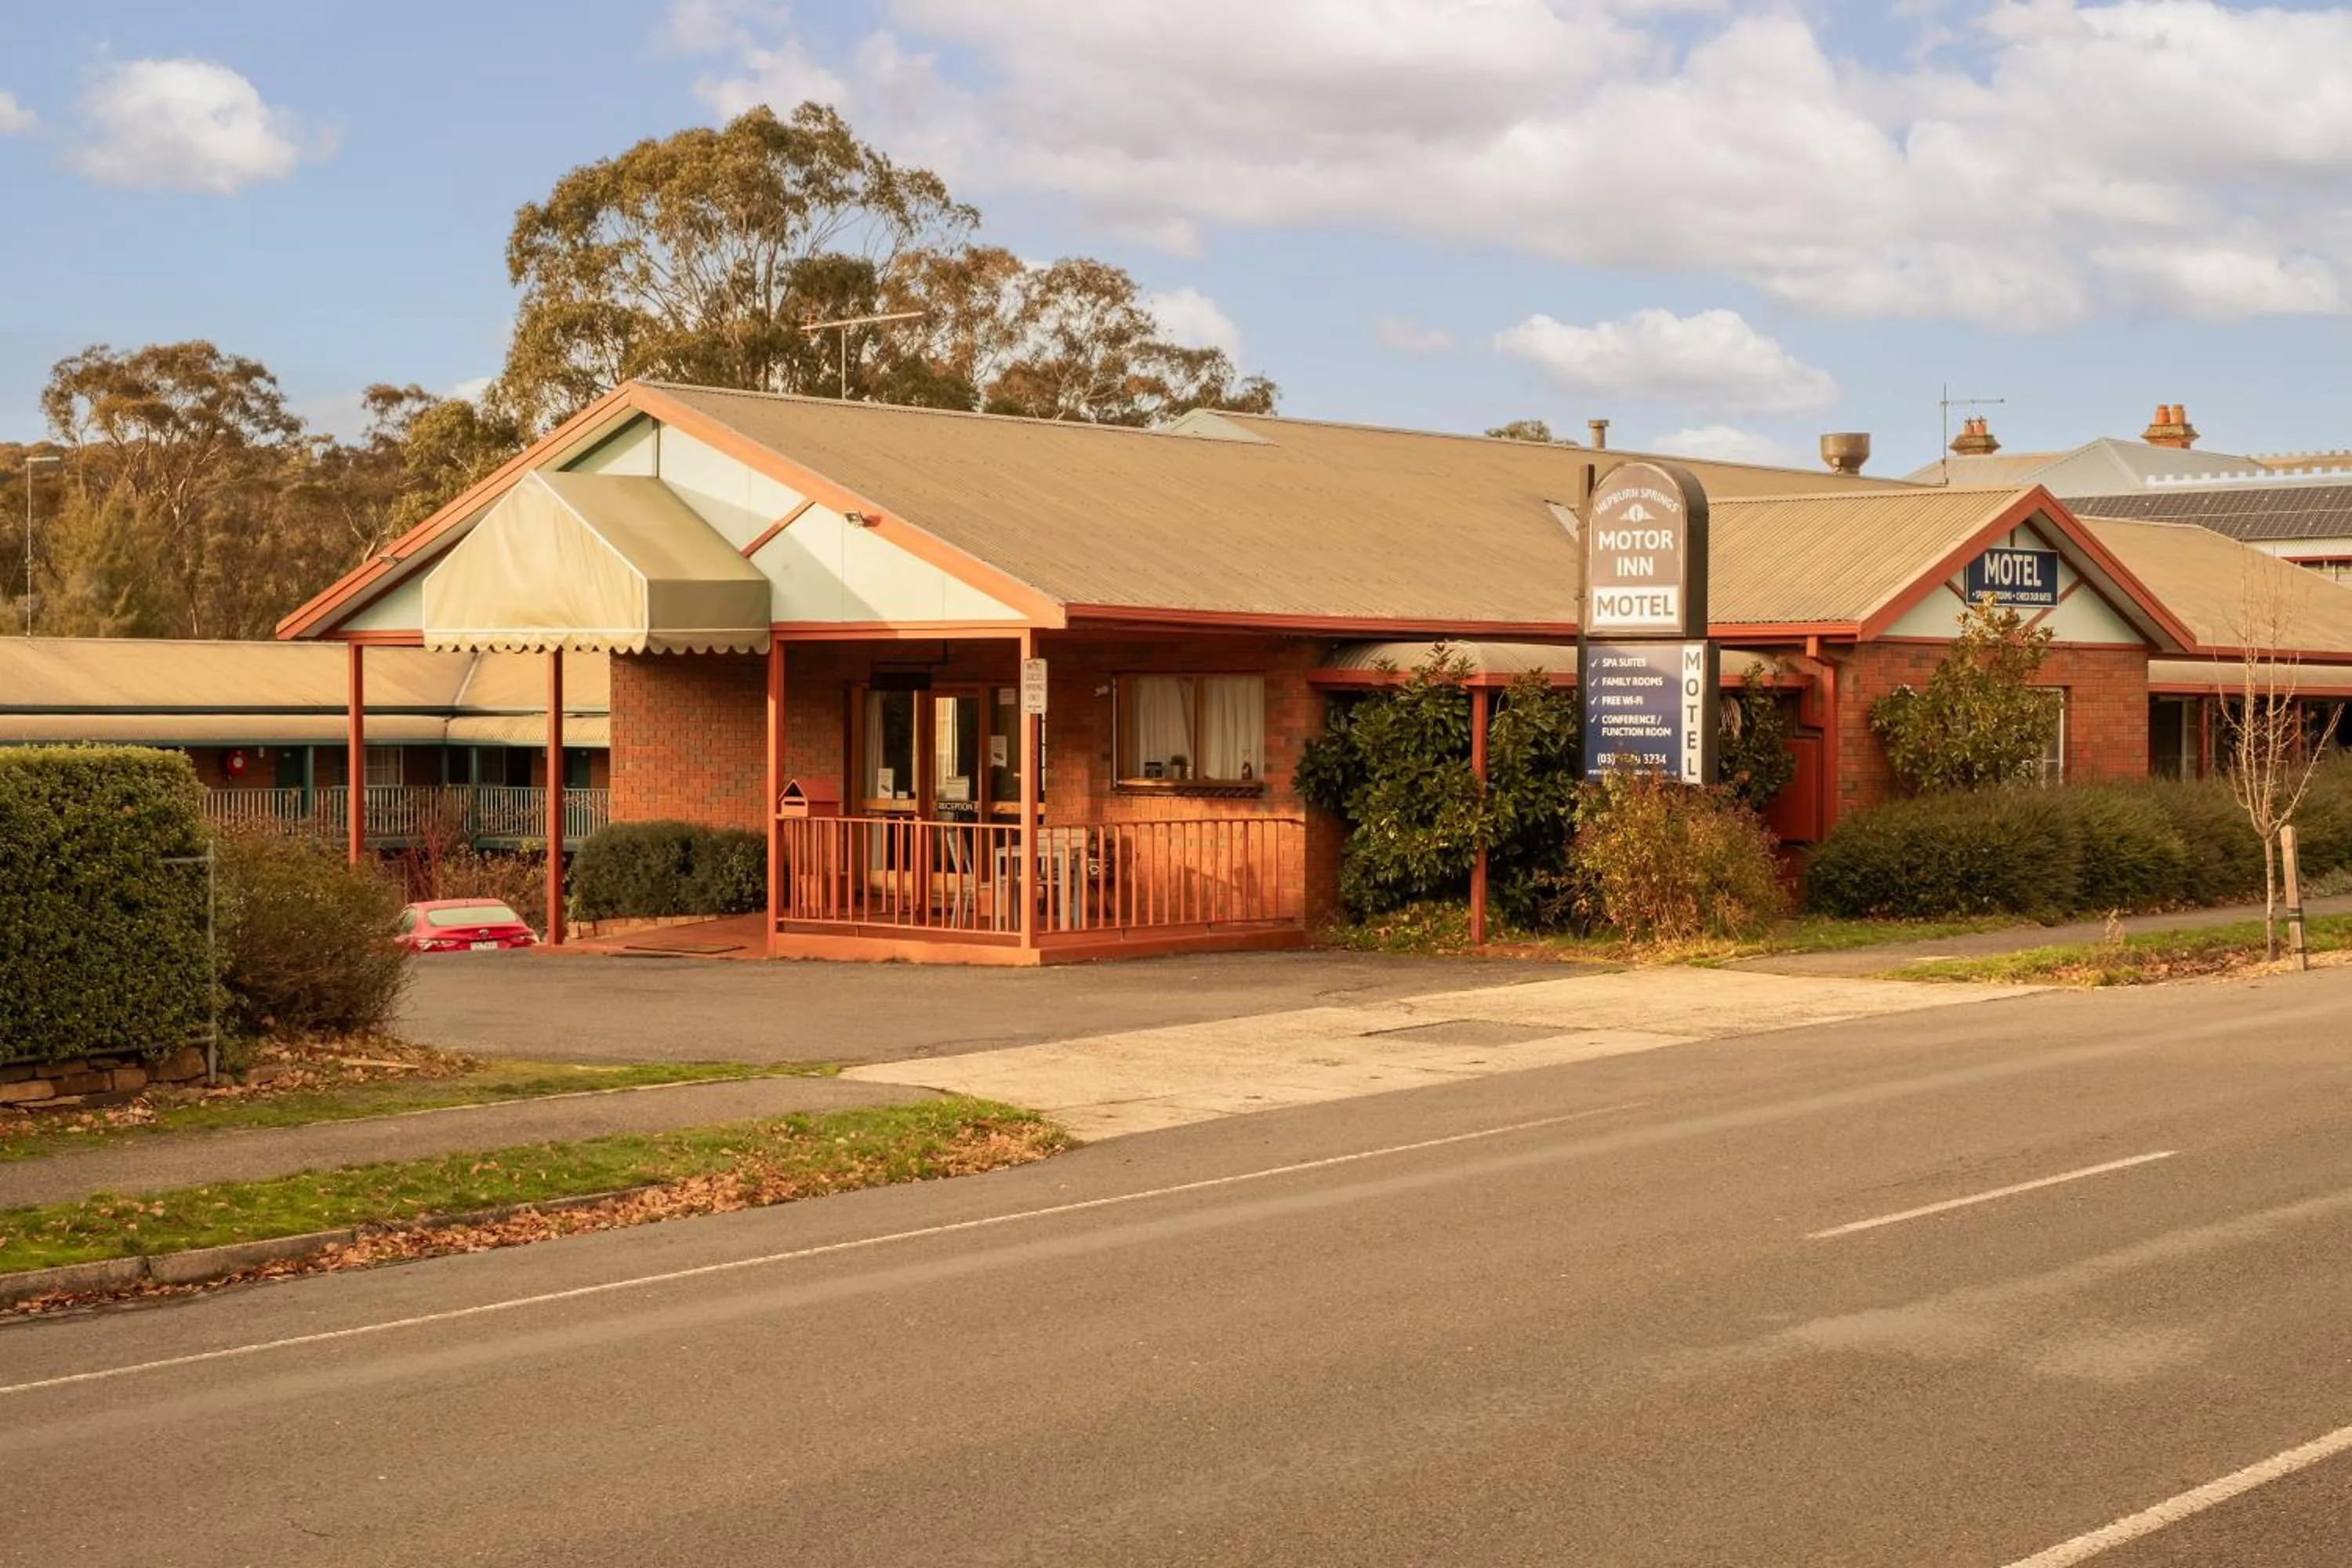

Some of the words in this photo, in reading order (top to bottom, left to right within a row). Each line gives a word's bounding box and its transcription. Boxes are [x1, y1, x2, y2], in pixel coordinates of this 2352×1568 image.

[1639, 488, 1680, 512] SPRINGS
[1599, 529, 1674, 550] MOTOR
[1617, 556, 1653, 577] INN
[1984, 551, 2042, 587] MOTEL
[1597, 594, 1675, 617] MOTEL
[1602, 658, 1617, 667] SPA
[1619, 658, 1646, 667] SUITES
[1602, 677, 1632, 687] FAMILY
[1632, 677, 1664, 687] ROOMS
[1602, 695, 1621, 706] FREE
[1622, 695, 1644, 706] WI-FI
[1602, 714, 1657, 724] CONFERENCE
[1685, 652, 1700, 776] MOTEL
[1602, 727, 1644, 737] FUNCTION
[1645, 727, 1672, 737] ROOM
[1597, 753, 1616, 766] (03)
[1643, 753, 1668, 765] 3234
[938, 802, 973, 811] RECEPTION
